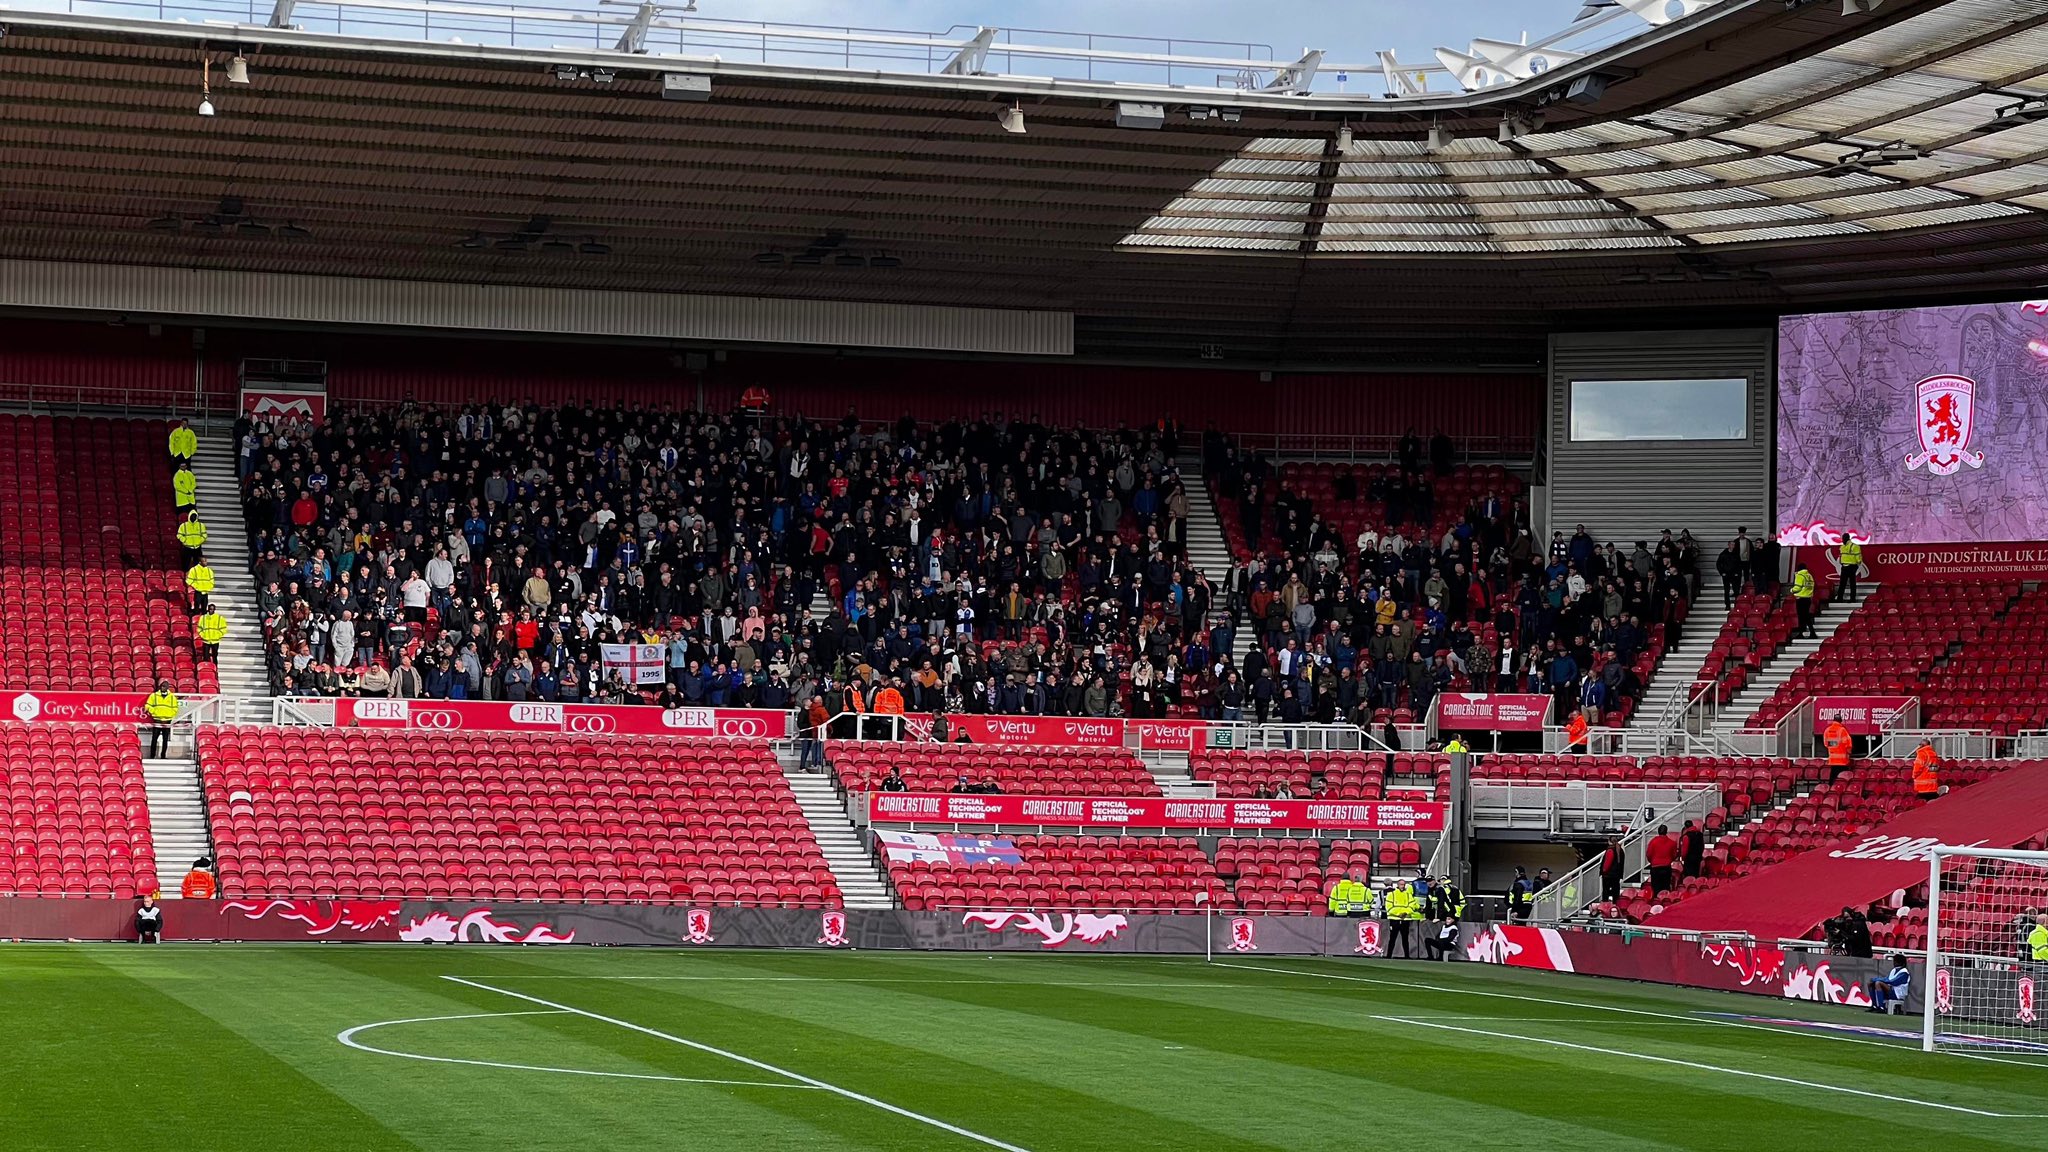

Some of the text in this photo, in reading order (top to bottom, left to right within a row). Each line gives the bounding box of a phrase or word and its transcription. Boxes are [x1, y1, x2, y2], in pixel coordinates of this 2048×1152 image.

[1877, 552, 1925, 564] GROUP
[1927, 550, 2012, 563] INDUSTRIAL
[2016, 550, 2035, 562] UK
[1947, 565, 1986, 573] DISCIPLINE
[18, 702, 33, 711] GS
[44, 701, 150, 718] Grey-Smith Leg
[363, 702, 402, 717] PER
[520, 706, 557, 722] PER
[1443, 704, 1494, 716] CORNERSTONE
[416, 711, 451, 728] CO
[571, 715, 605, 733] CO
[671, 711, 708, 726] PER
[918, 718, 954, 732] Veu
[722, 719, 757, 736] CO
[1000, 720, 1035, 734] Vertu
[1077, 722, 1113, 736] Vertu
[878, 796, 941, 812] CORNERSTONE
[1022, 800, 1085, 815] CORNERSTONE
[1165, 803, 1227, 818] CORNERSTONE
[1234, 810, 1288, 818] TECHNOLOGY
[1306, 804, 1370, 820] CORNERSTONE
